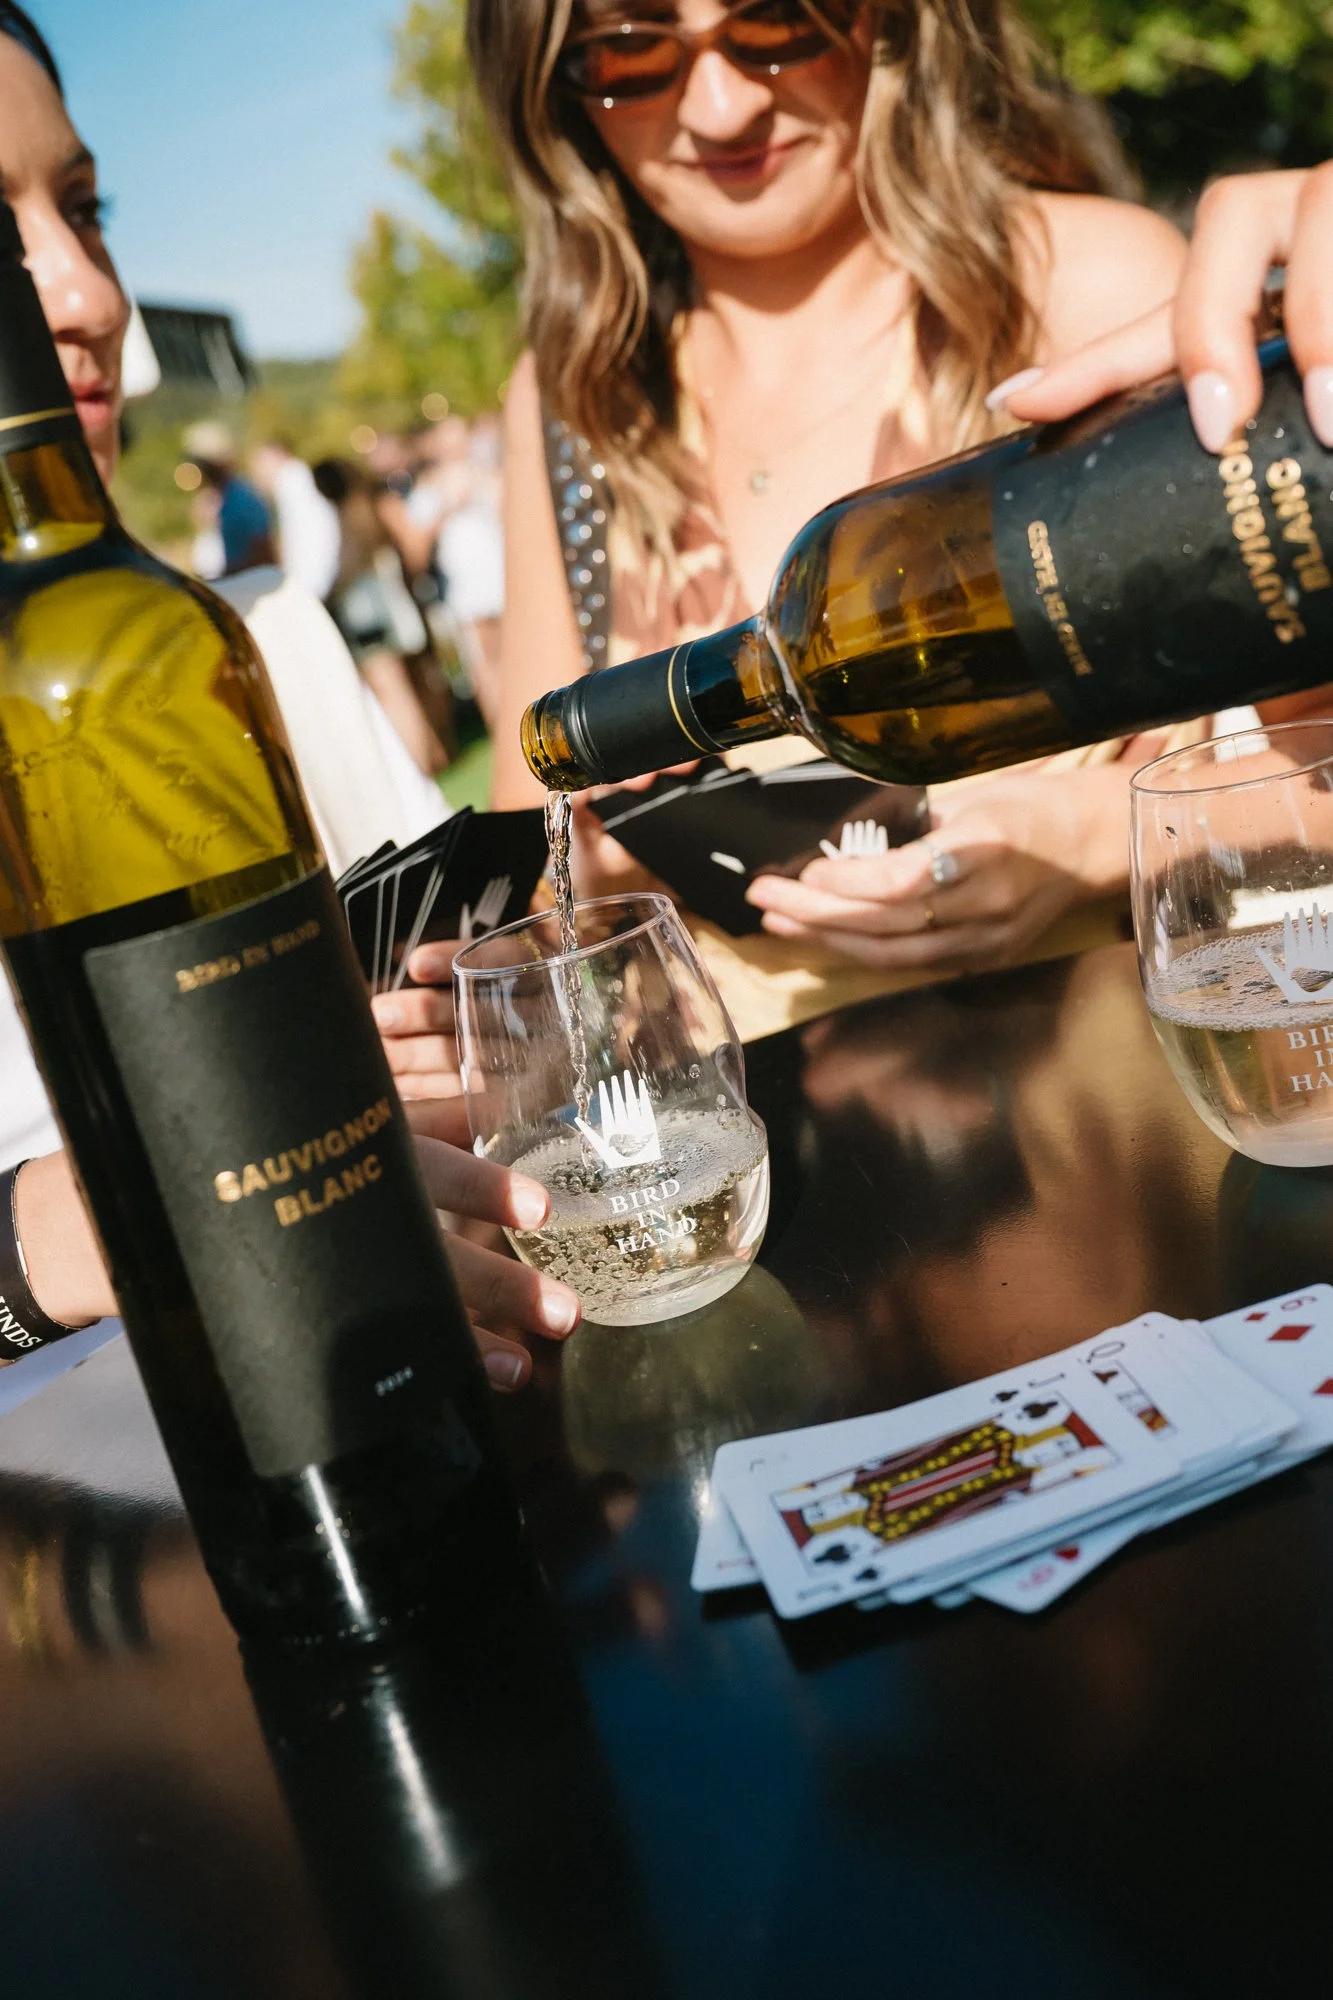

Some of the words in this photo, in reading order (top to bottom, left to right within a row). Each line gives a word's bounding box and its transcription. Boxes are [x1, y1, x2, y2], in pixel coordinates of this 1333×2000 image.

[1265, 457, 1331, 592] BLANC
[214, 1096, 391, 1203] SAUVIGNON
[274, 1153, 383, 1228] BLANC
[608, 1178, 680, 1214] BIRD
[635, 1205, 668, 1229] IN
[615, 1217, 698, 1255] HAND
